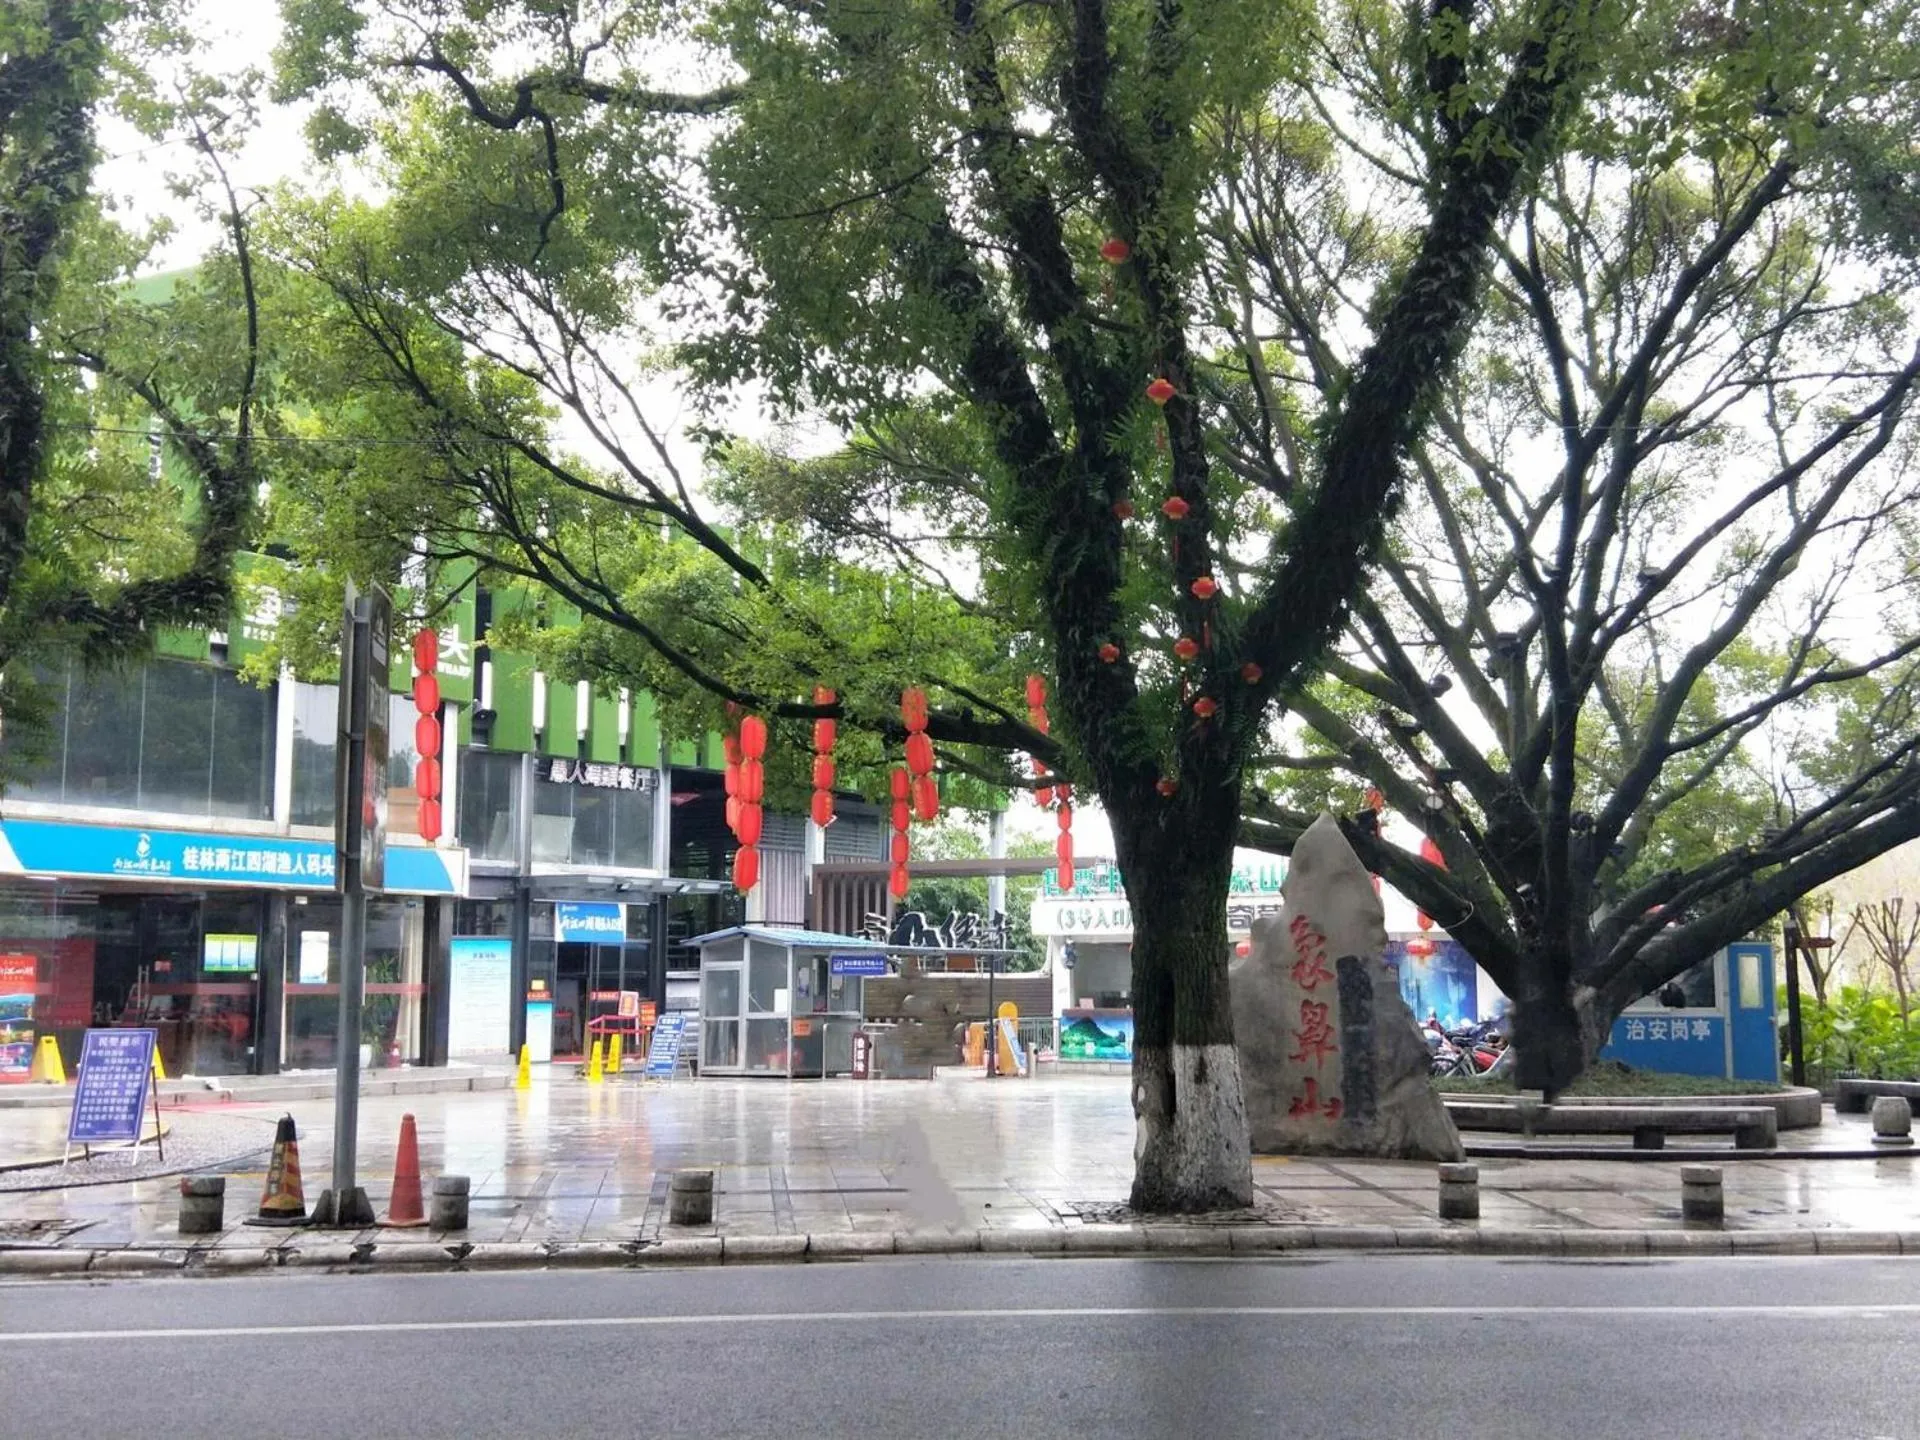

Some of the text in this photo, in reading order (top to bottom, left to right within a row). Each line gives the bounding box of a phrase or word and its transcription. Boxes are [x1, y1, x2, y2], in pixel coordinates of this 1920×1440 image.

[182, 846, 335, 878] 桂林两江四湖渔人码头
[1625, 1018, 1711, 1042] 治安岗亭
